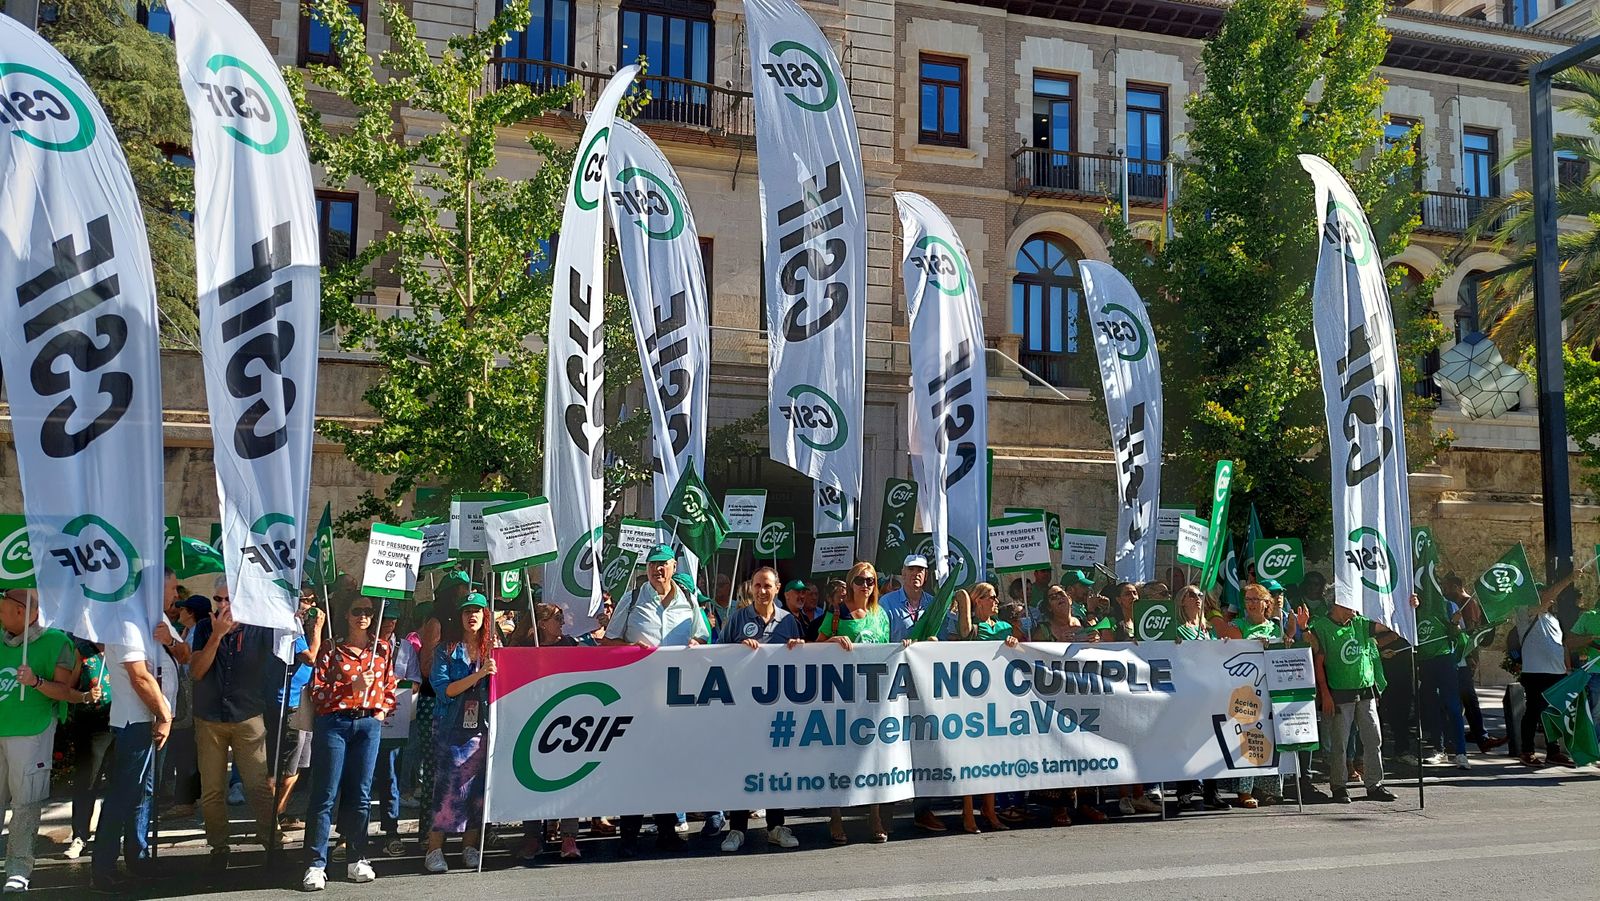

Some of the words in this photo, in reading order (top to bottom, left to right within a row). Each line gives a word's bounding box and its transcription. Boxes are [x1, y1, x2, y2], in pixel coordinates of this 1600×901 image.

[585, 152, 607, 182] CS
[893, 490, 914, 501] CSIF
[762, 531, 789, 544] CSIF
[1006, 527, 1044, 536] PRESIDENTE
[370, 538, 386, 547] ESTE
[386, 541, 420, 553] PRESIDENTE
[1010, 535, 1035, 543] CUMPLE
[7, 541, 32, 561] CS
[387, 551, 411, 560] CUMPLE
[920, 546, 935, 556] CS
[372, 558, 385, 566] CON
[394, 561, 413, 570] GENTE
[1265, 555, 1297, 568] CSIF
[1146, 616, 1171, 630] CSIF
[0, 678, 19, 692] SIF
[667, 666, 736, 707] LA
[752, 662, 920, 705] JUNTA
[933, 659, 991, 699] NO
[1004, 658, 1175, 698] CUMPLE
[1234, 698, 1258, 709] Acción
[1234, 706, 1257, 716] Social
[770, 701, 1100, 747] #AlcemosLaVoz
[538, 716, 633, 754] CSIF
[1247, 738, 1264, 746] Extra
[744, 772, 764, 792] Si
[769, 772, 792, 792] tú
[797, 774, 824, 791] no
[829, 772, 851, 789] te
[854, 765, 956, 788] conformas,
[960, 758, 1038, 779] nosotr@s
[1042, 756, 1119, 778] tampoco
